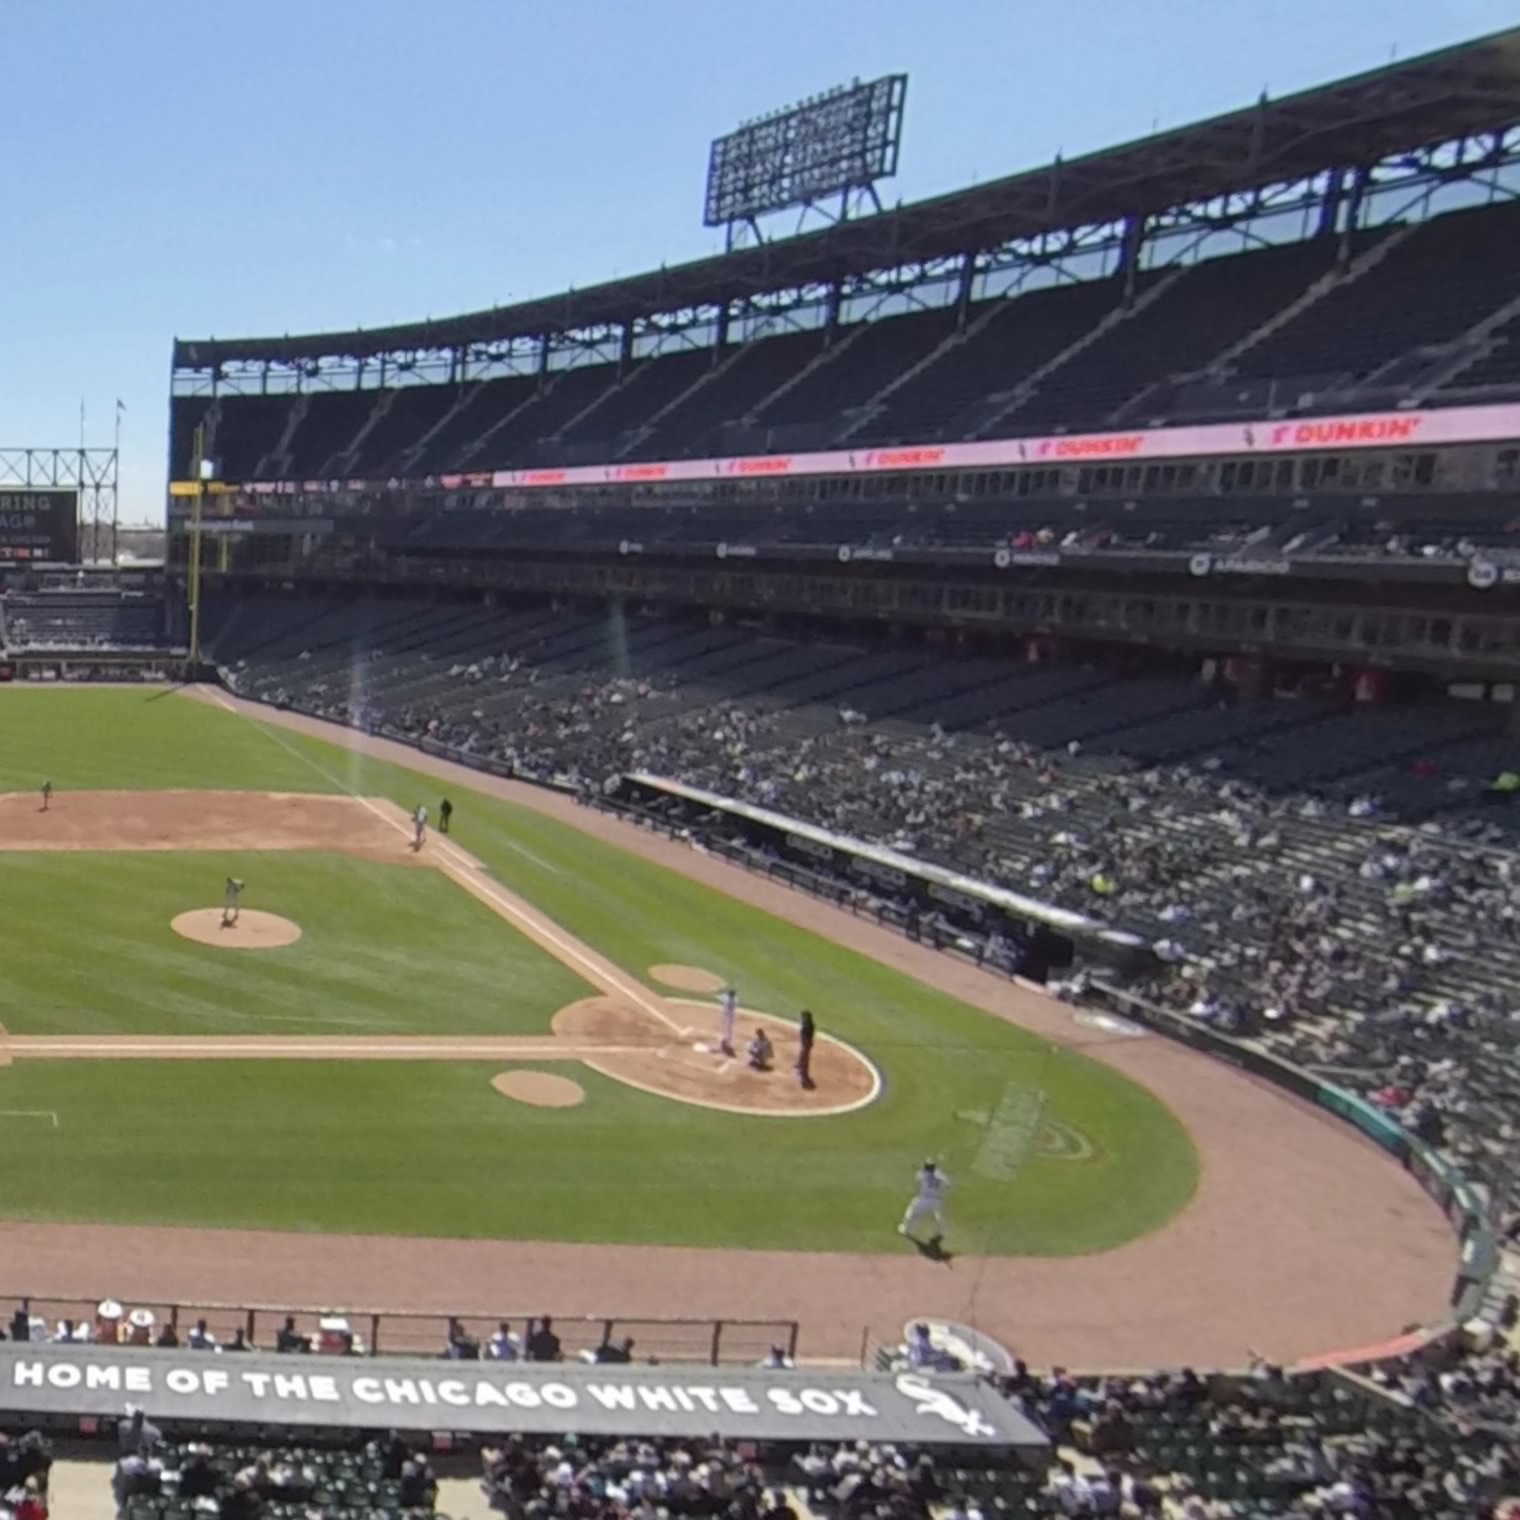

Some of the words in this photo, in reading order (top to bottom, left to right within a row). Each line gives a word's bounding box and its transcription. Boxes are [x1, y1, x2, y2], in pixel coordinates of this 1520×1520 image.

[1294, 417, 1424, 443] DUNKIN'
[13, 1361, 152, 1392] HOME
[166, 1369, 229, 1396] OF
[242, 1372, 339, 1401] THE
[351, 1377, 576, 1409] CHICAGO
[587, 1382, 760, 1414] WHITE
[767, 1386, 877, 1417] SOX
